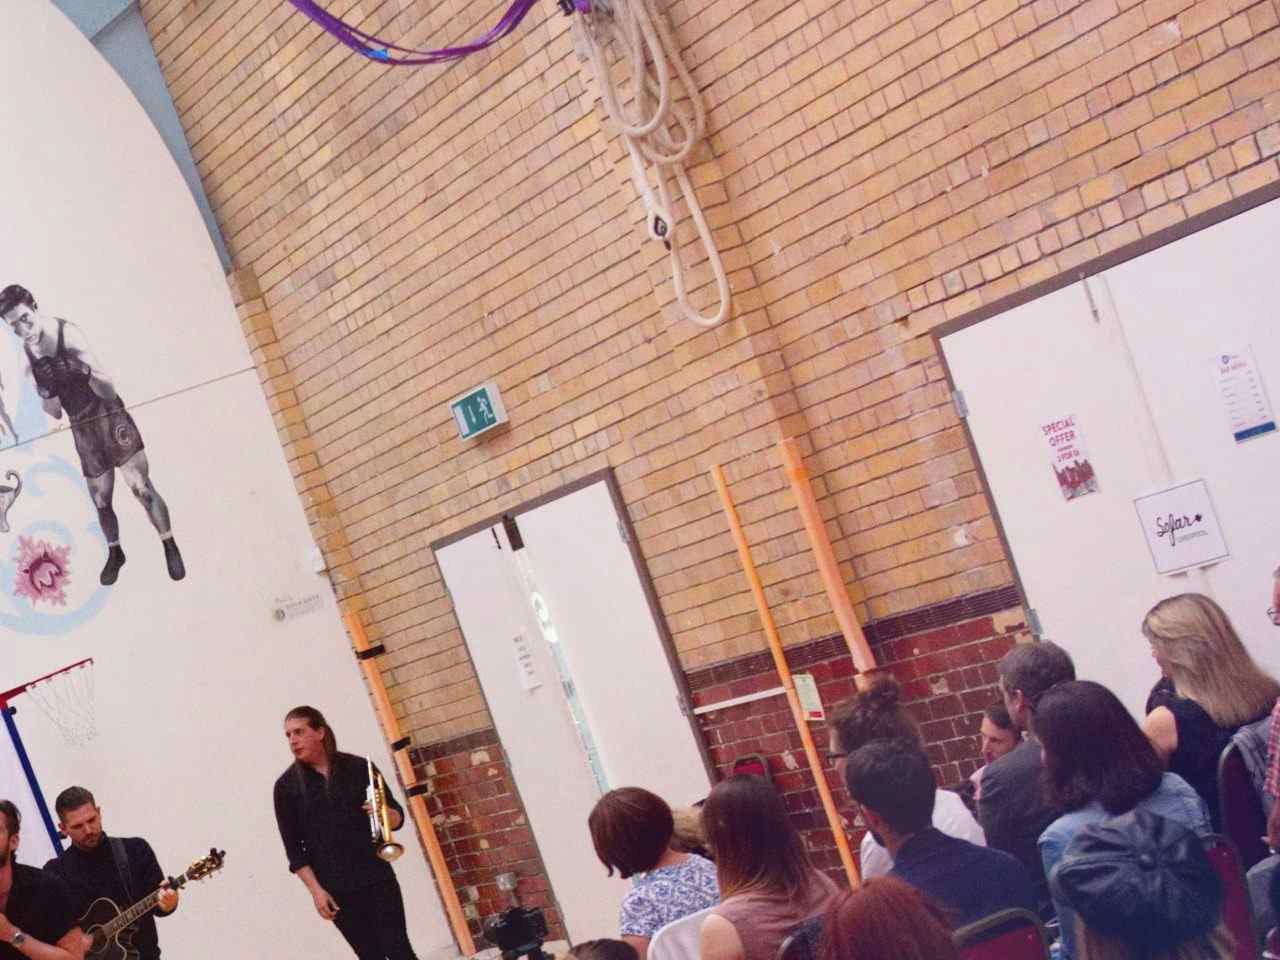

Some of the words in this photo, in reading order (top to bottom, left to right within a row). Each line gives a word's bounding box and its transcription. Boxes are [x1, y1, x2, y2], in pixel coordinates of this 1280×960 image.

[1041, 416, 1075, 436] SPECIAL
[1049, 430, 1075, 447] OFFER
[1156, 513, 1194, 547] Sofar
